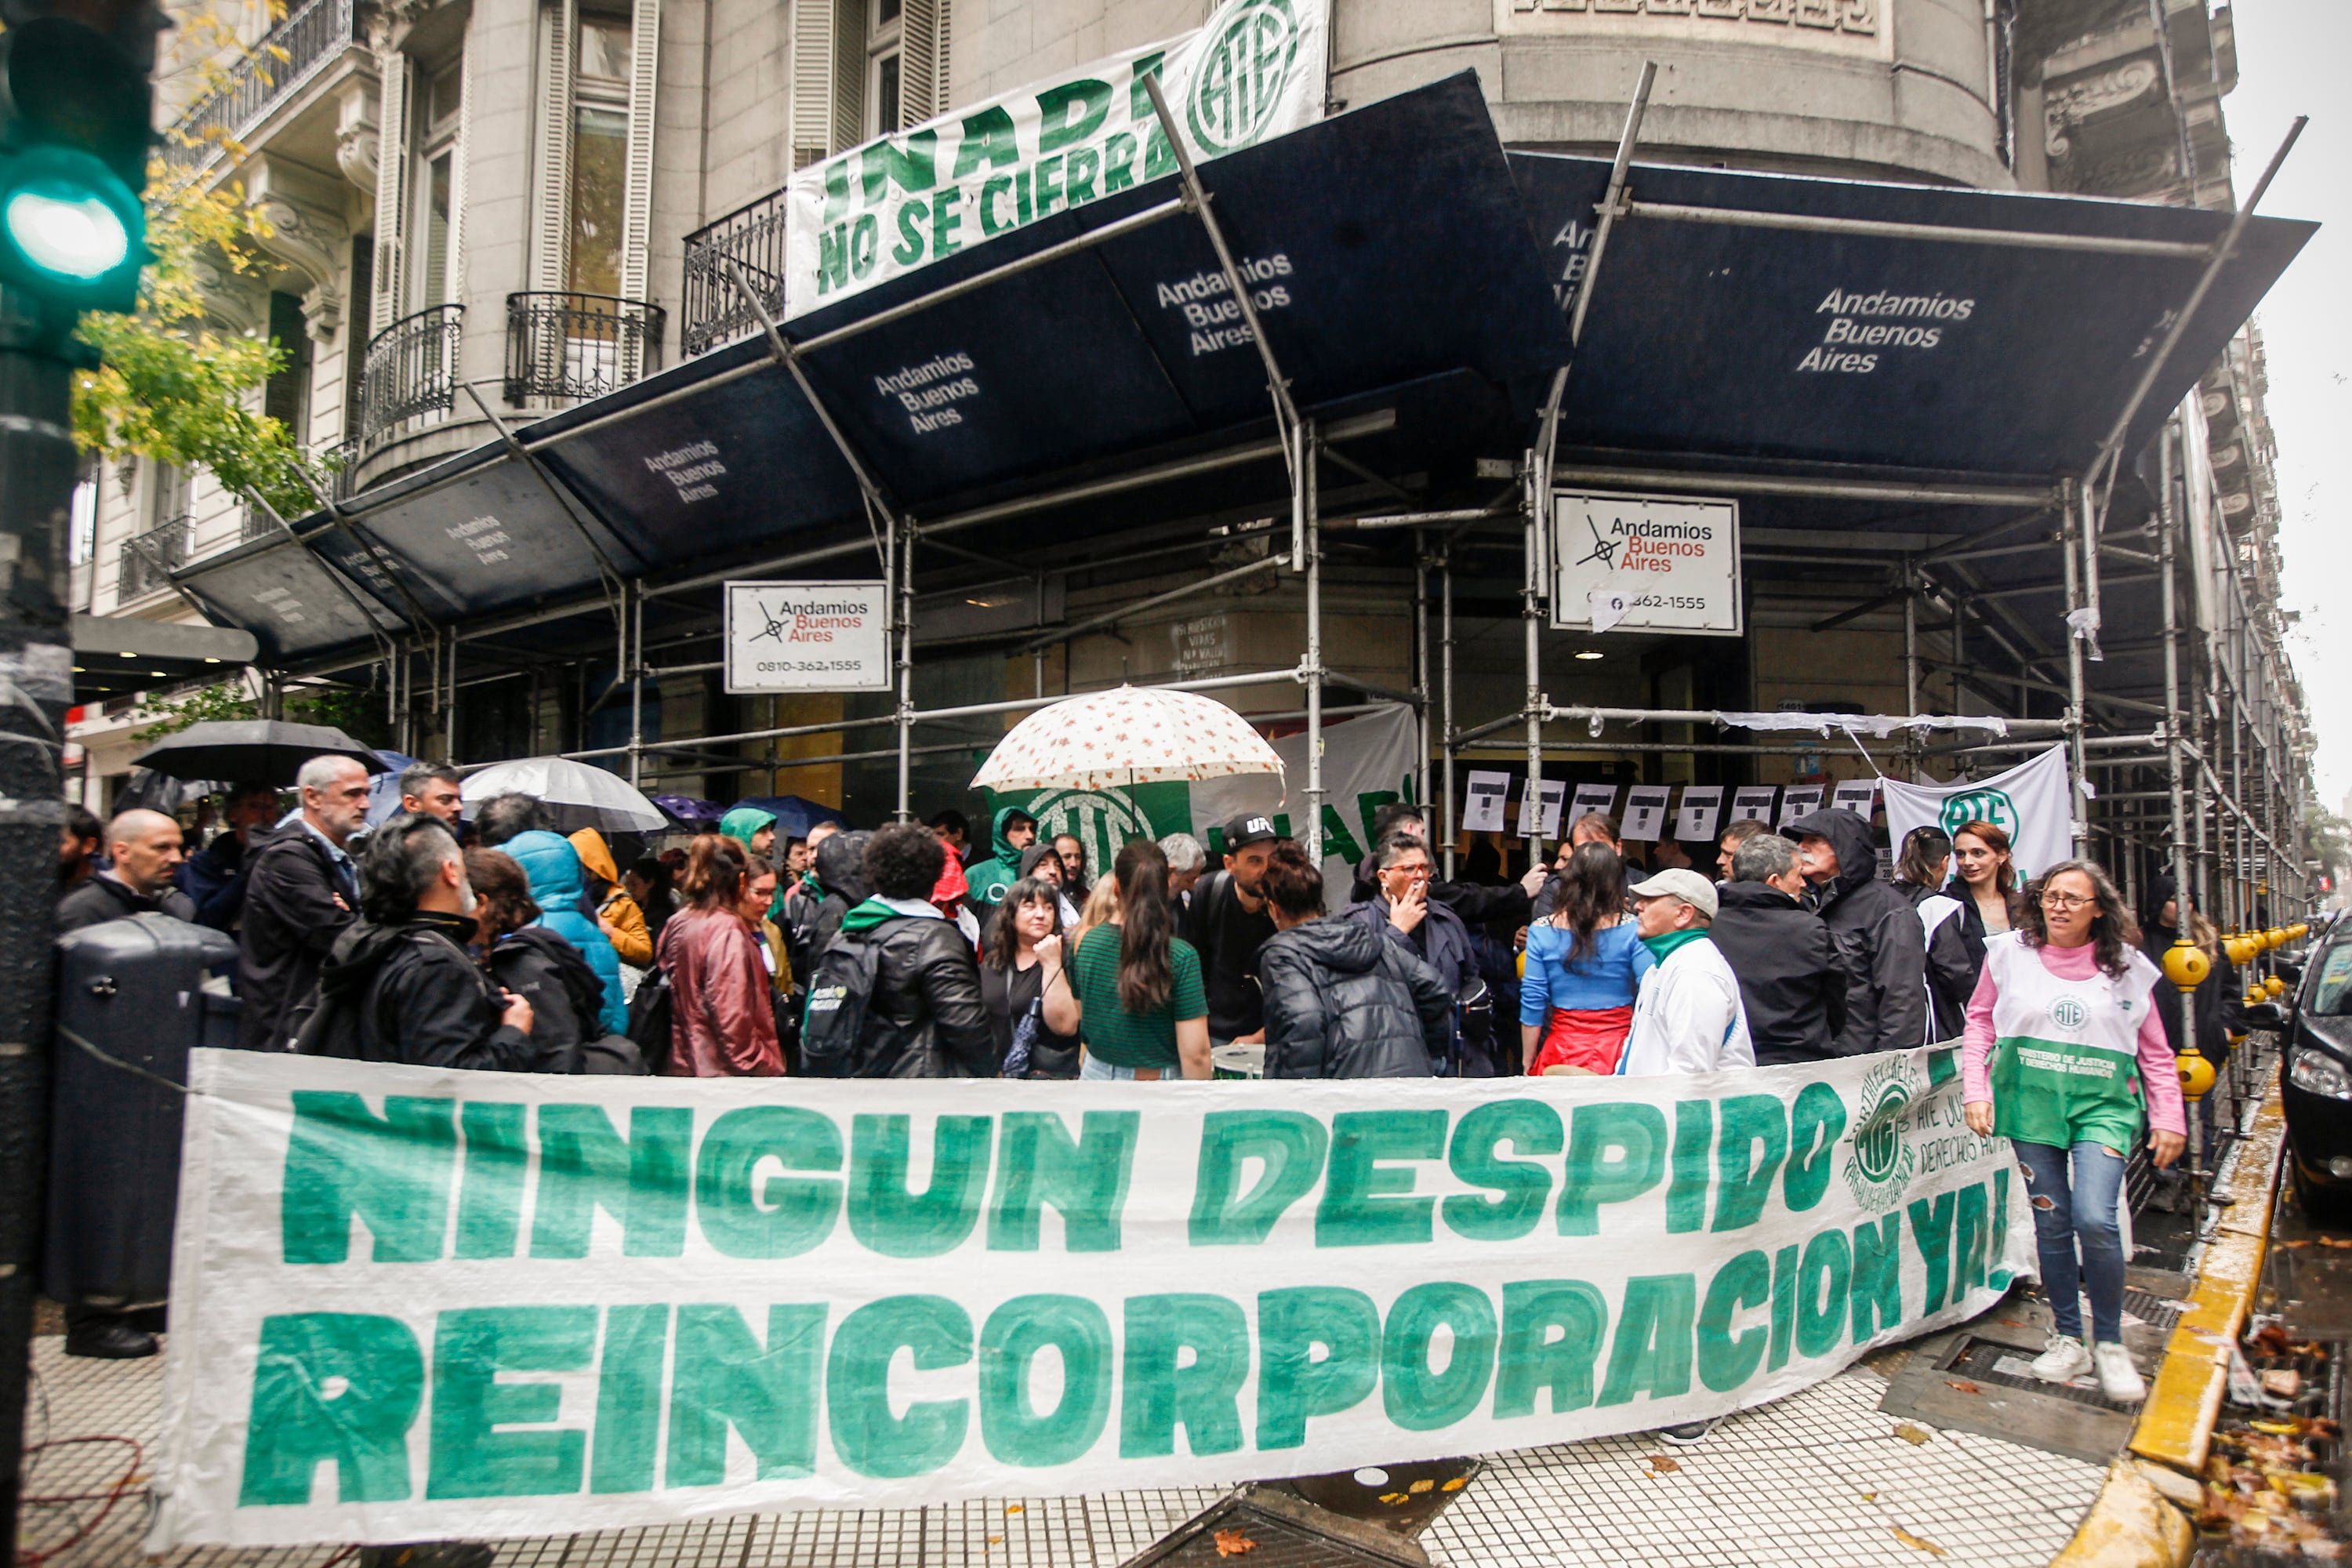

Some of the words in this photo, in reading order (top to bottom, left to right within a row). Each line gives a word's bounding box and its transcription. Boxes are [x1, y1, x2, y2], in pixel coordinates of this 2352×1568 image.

[818, 212, 879, 295] NO
[892, 185, 962, 266] SE
[980, 118, 1181, 237] CIERRA
[1183, 285, 1291, 328] Bueos
[1816, 287, 1975, 321] Andamios
[1190, 323, 1256, 357] Aires
[1824, 318, 1944, 348] Buenos
[874, 352, 975, 396] Andamios
[1795, 346, 1879, 374] Aires
[898, 377, 979, 412] Buenos
[909, 408, 963, 434] Aires
[644, 439, 720, 474] Andamios
[666, 459, 728, 487] Buenos
[677, 483, 720, 504] Aires
[1610, 517, 1712, 540] Andamios
[1628, 535, 1705, 557] Buenos
[1621, 553, 1672, 572] Aires
[780, 601, 868, 615] Andamios
[796, 614, 862, 629] Buenos
[788, 628, 833, 642] Aires
[2055, 1003, 2082, 1024] ATE
[2020, 1056, 2025, 1065] Y
[2062, 1054, 2076, 1064] DE
[2076, 1056, 2117, 1071] JUSTICIA
[1917, 1095, 1941, 1130] ATE
[281, 1089, 1140, 1264] NINGUN
[1187, 1080, 1848, 1248] DESPIDO
[239, 1210, 1901, 1508] REINCORPORACION
